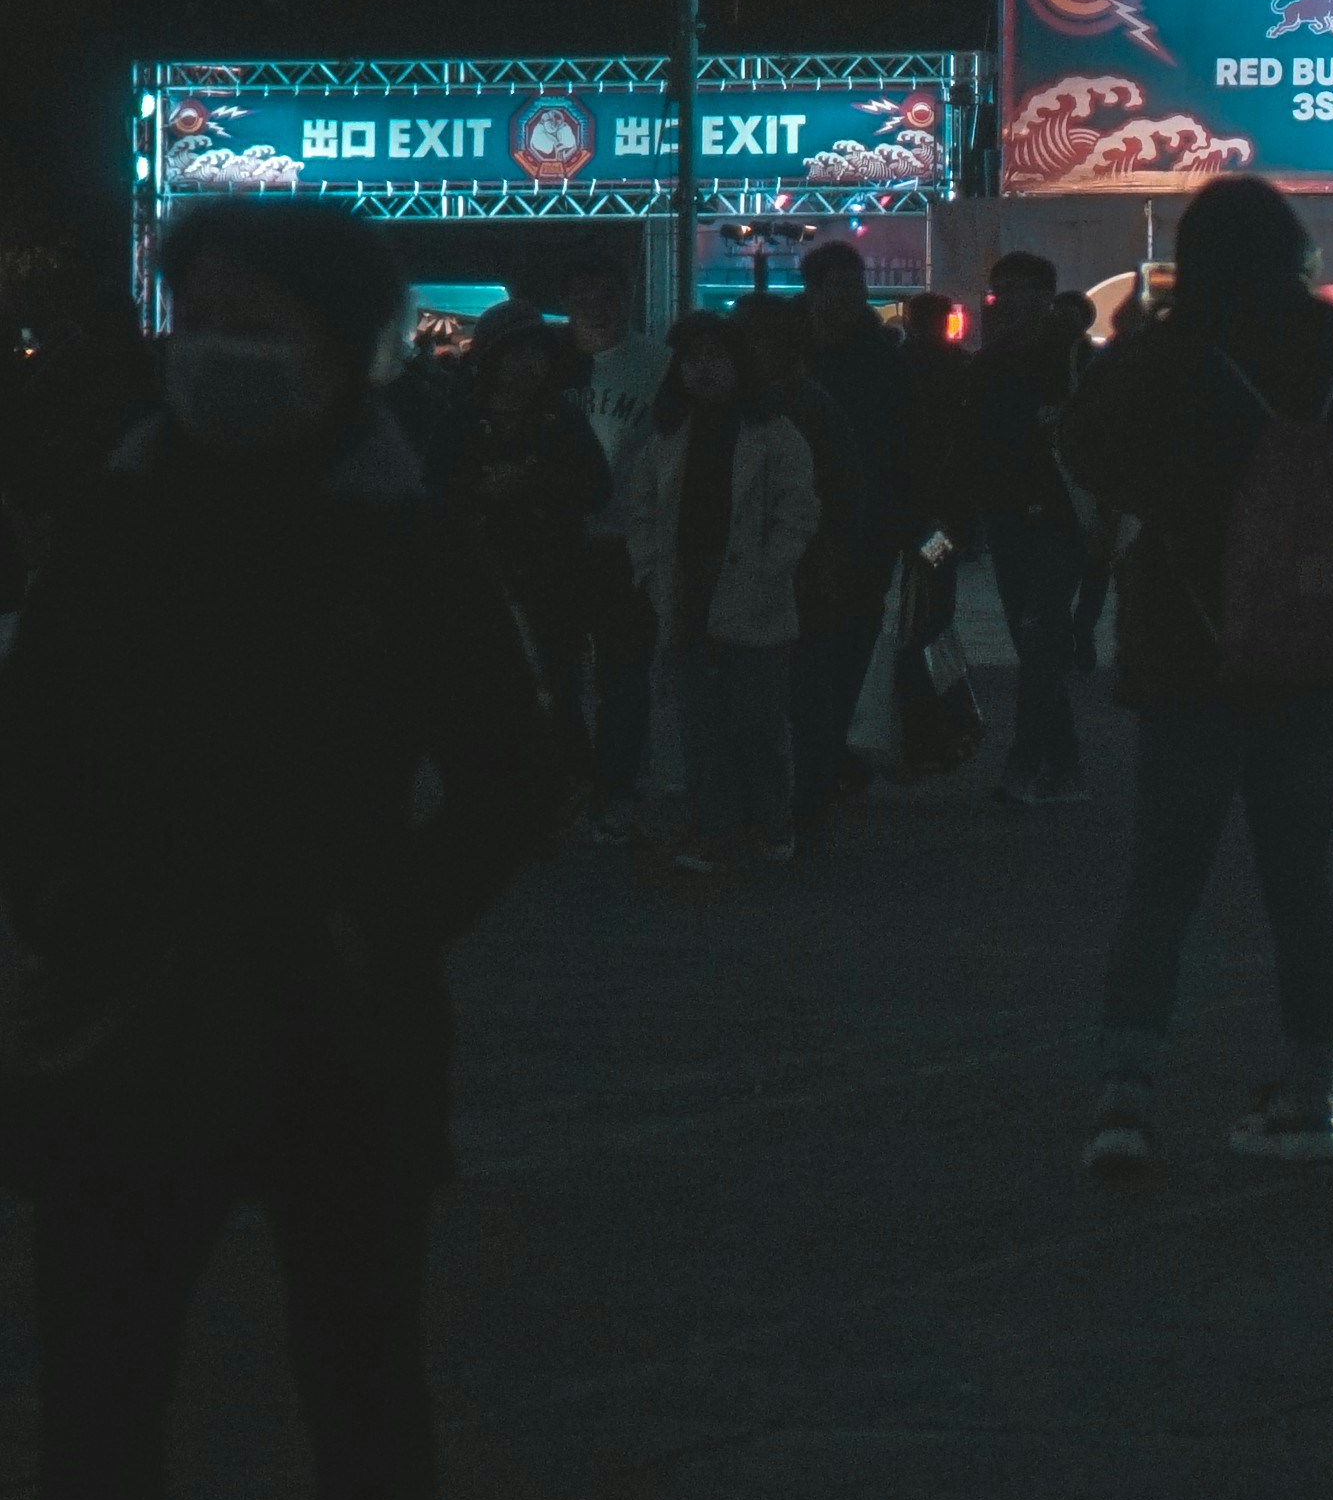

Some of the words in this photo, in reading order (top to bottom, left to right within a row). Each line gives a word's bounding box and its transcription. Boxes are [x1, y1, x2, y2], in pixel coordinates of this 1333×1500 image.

[1215, 57, 1283, 86] RED
[302, 119, 376, 158] 出口
[388, 118, 492, 158] EXIT
[701, 114, 807, 155] EXIT
